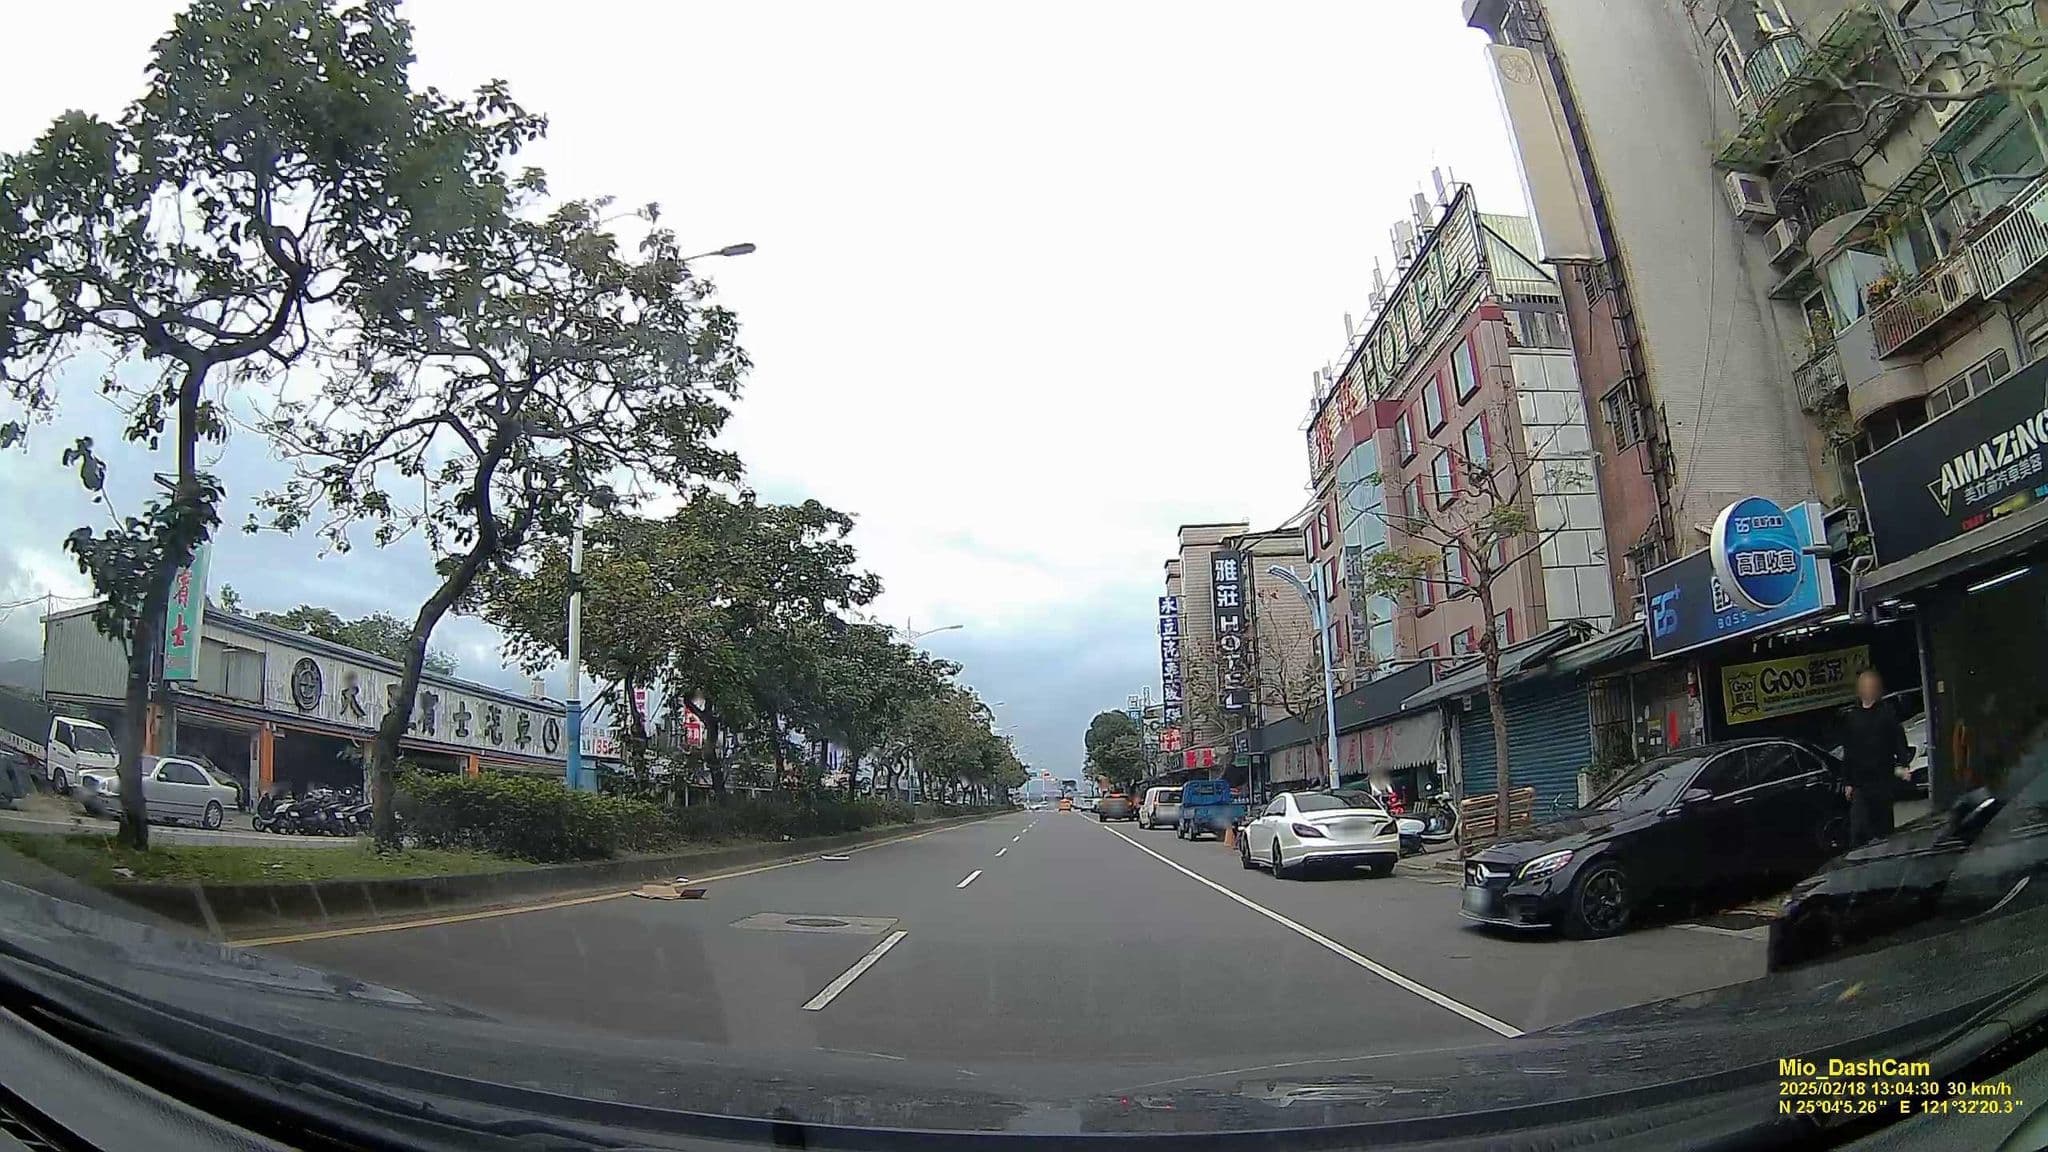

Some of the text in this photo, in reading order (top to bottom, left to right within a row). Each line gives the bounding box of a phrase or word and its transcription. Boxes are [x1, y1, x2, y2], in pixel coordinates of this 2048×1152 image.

[1360, 241, 1467, 403] HOTEL
[1736, 548, 1797, 576] 高價收車
[1214, 558, 1239, 608] 雅莊
[1219, 615, 1245, 710] HOTEL
[1759, 666, 1807, 695] Goo
[1732, 680, 1753, 692] Goo
